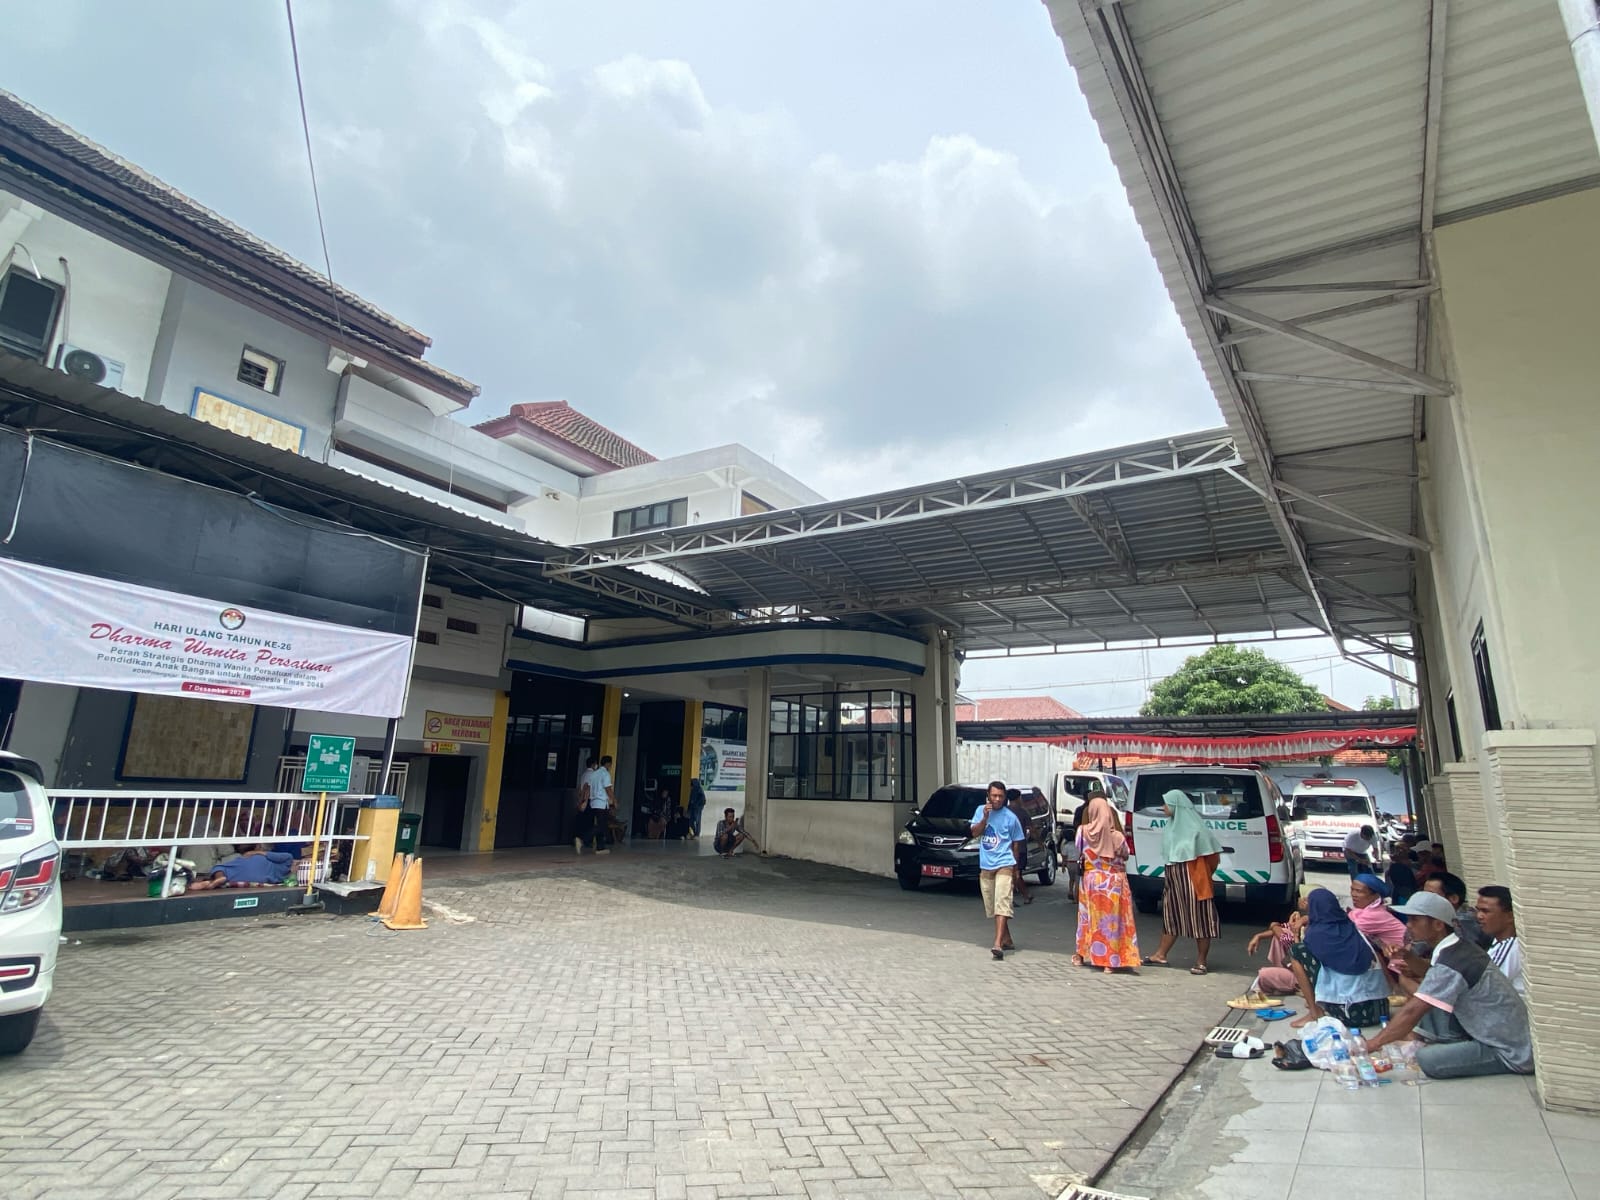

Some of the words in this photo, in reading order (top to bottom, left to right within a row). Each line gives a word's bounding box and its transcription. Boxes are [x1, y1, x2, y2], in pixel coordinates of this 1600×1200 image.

[89, 622, 172, 650] Dharma
[183, 637, 248, 661] Wanita
[255, 649, 334, 673] Persatuan
[153, 621, 182, 633] HARI
[186, 627, 223, 640] ULANG
[227, 633, 261, 646] TAHUN
[264, 640, 292, 651] KE-26
[97, 653, 153, 667] Pendidikan
[155, 661, 180, 671] Anak
[181, 665, 215, 676] Bangsa
[217, 670, 241, 679] untuk
[243, 673, 281, 684] Indonesia
[283, 677, 305, 687] Emas
[110, 646, 140, 657] Peran
[142, 650, 185, 663] Strategis
[187, 657, 221, 668] Dharma
[223, 661, 252, 672] Wanita
[254, 664, 292, 677] Persatuan
[194, 685, 229, 694] Desember
[1150, 818, 1248, 831] AMANCE
